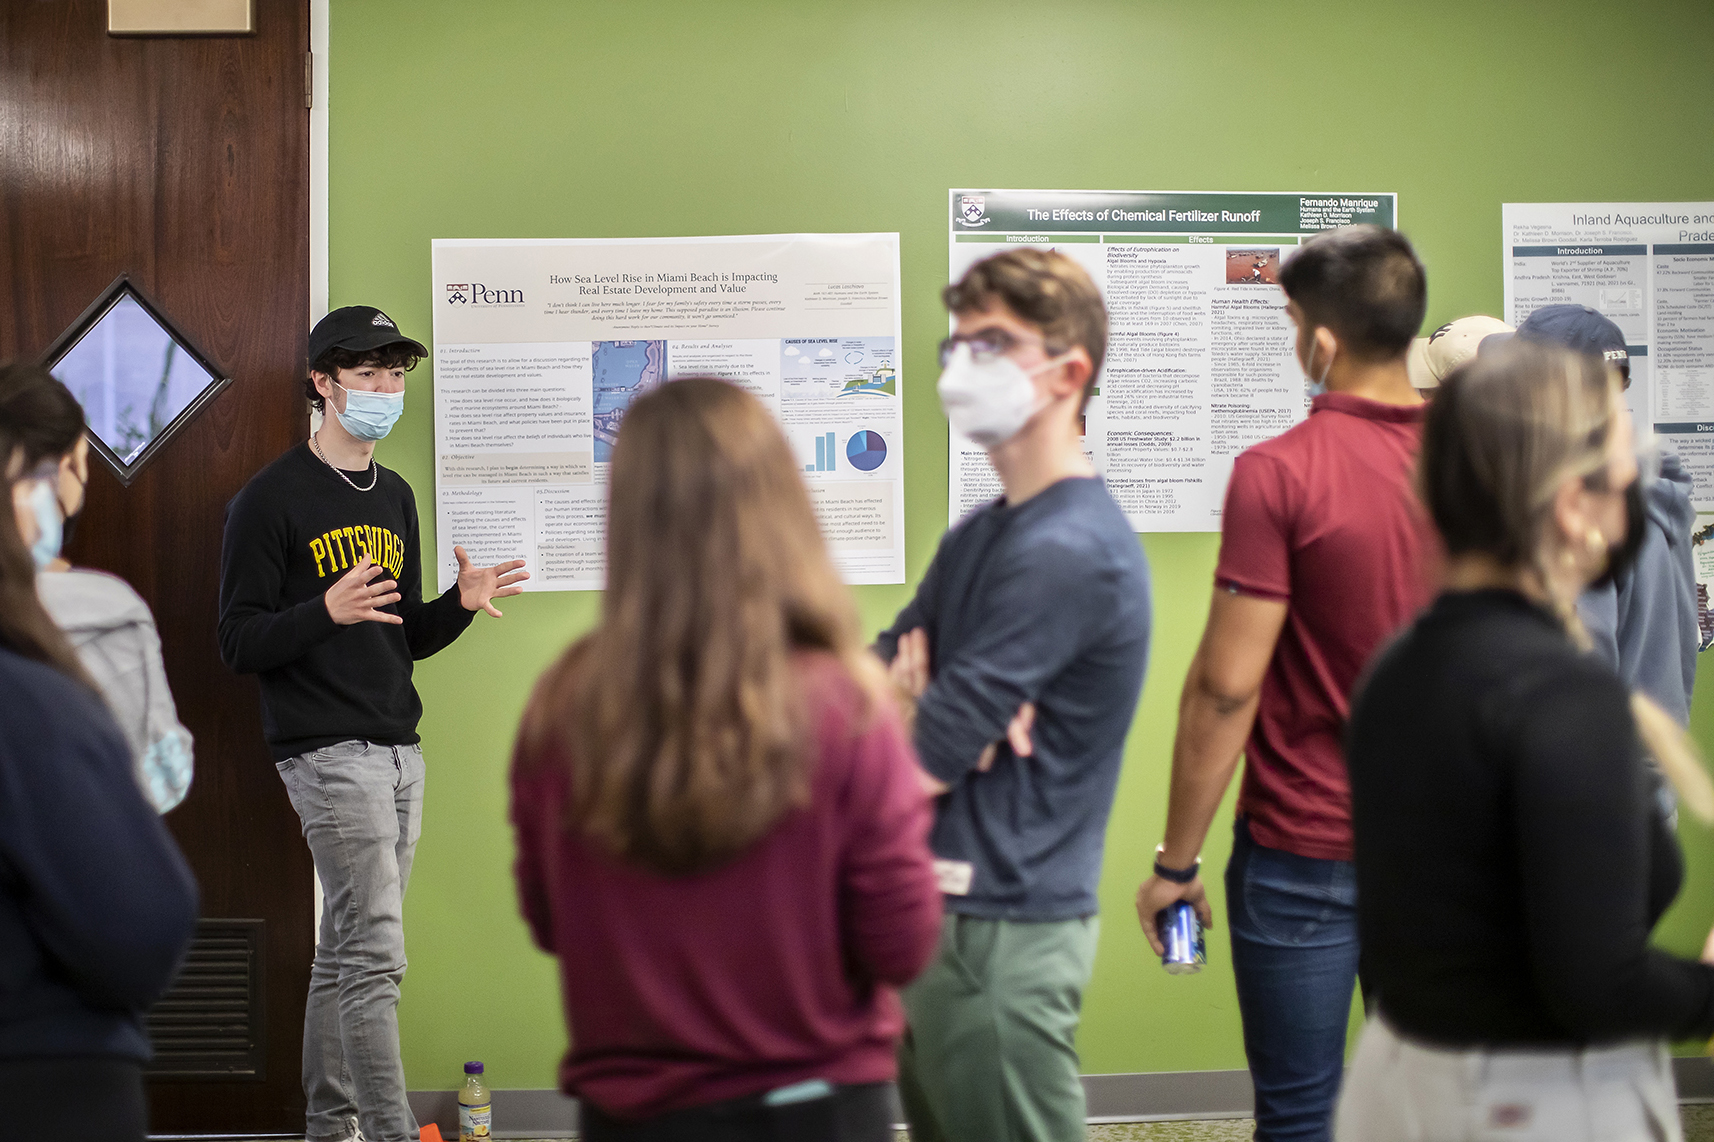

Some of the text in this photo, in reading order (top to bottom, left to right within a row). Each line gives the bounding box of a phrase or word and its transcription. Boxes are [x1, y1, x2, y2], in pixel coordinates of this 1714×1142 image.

[1300, 198, 1379, 208] Fernando Manrique
[1027, 209, 1260, 222] The Effects of Chemical Fertilizer Runoff
[1573, 214, 1611, 225] Inland
[1615, 214, 1688, 227] Aquaculture
[549, 272, 778, 284] How Sea Level Rise in Miami Beach is Impacting
[471, 283, 525, 304] Penn
[579, 284, 747, 296] Real Estate Development and Value
